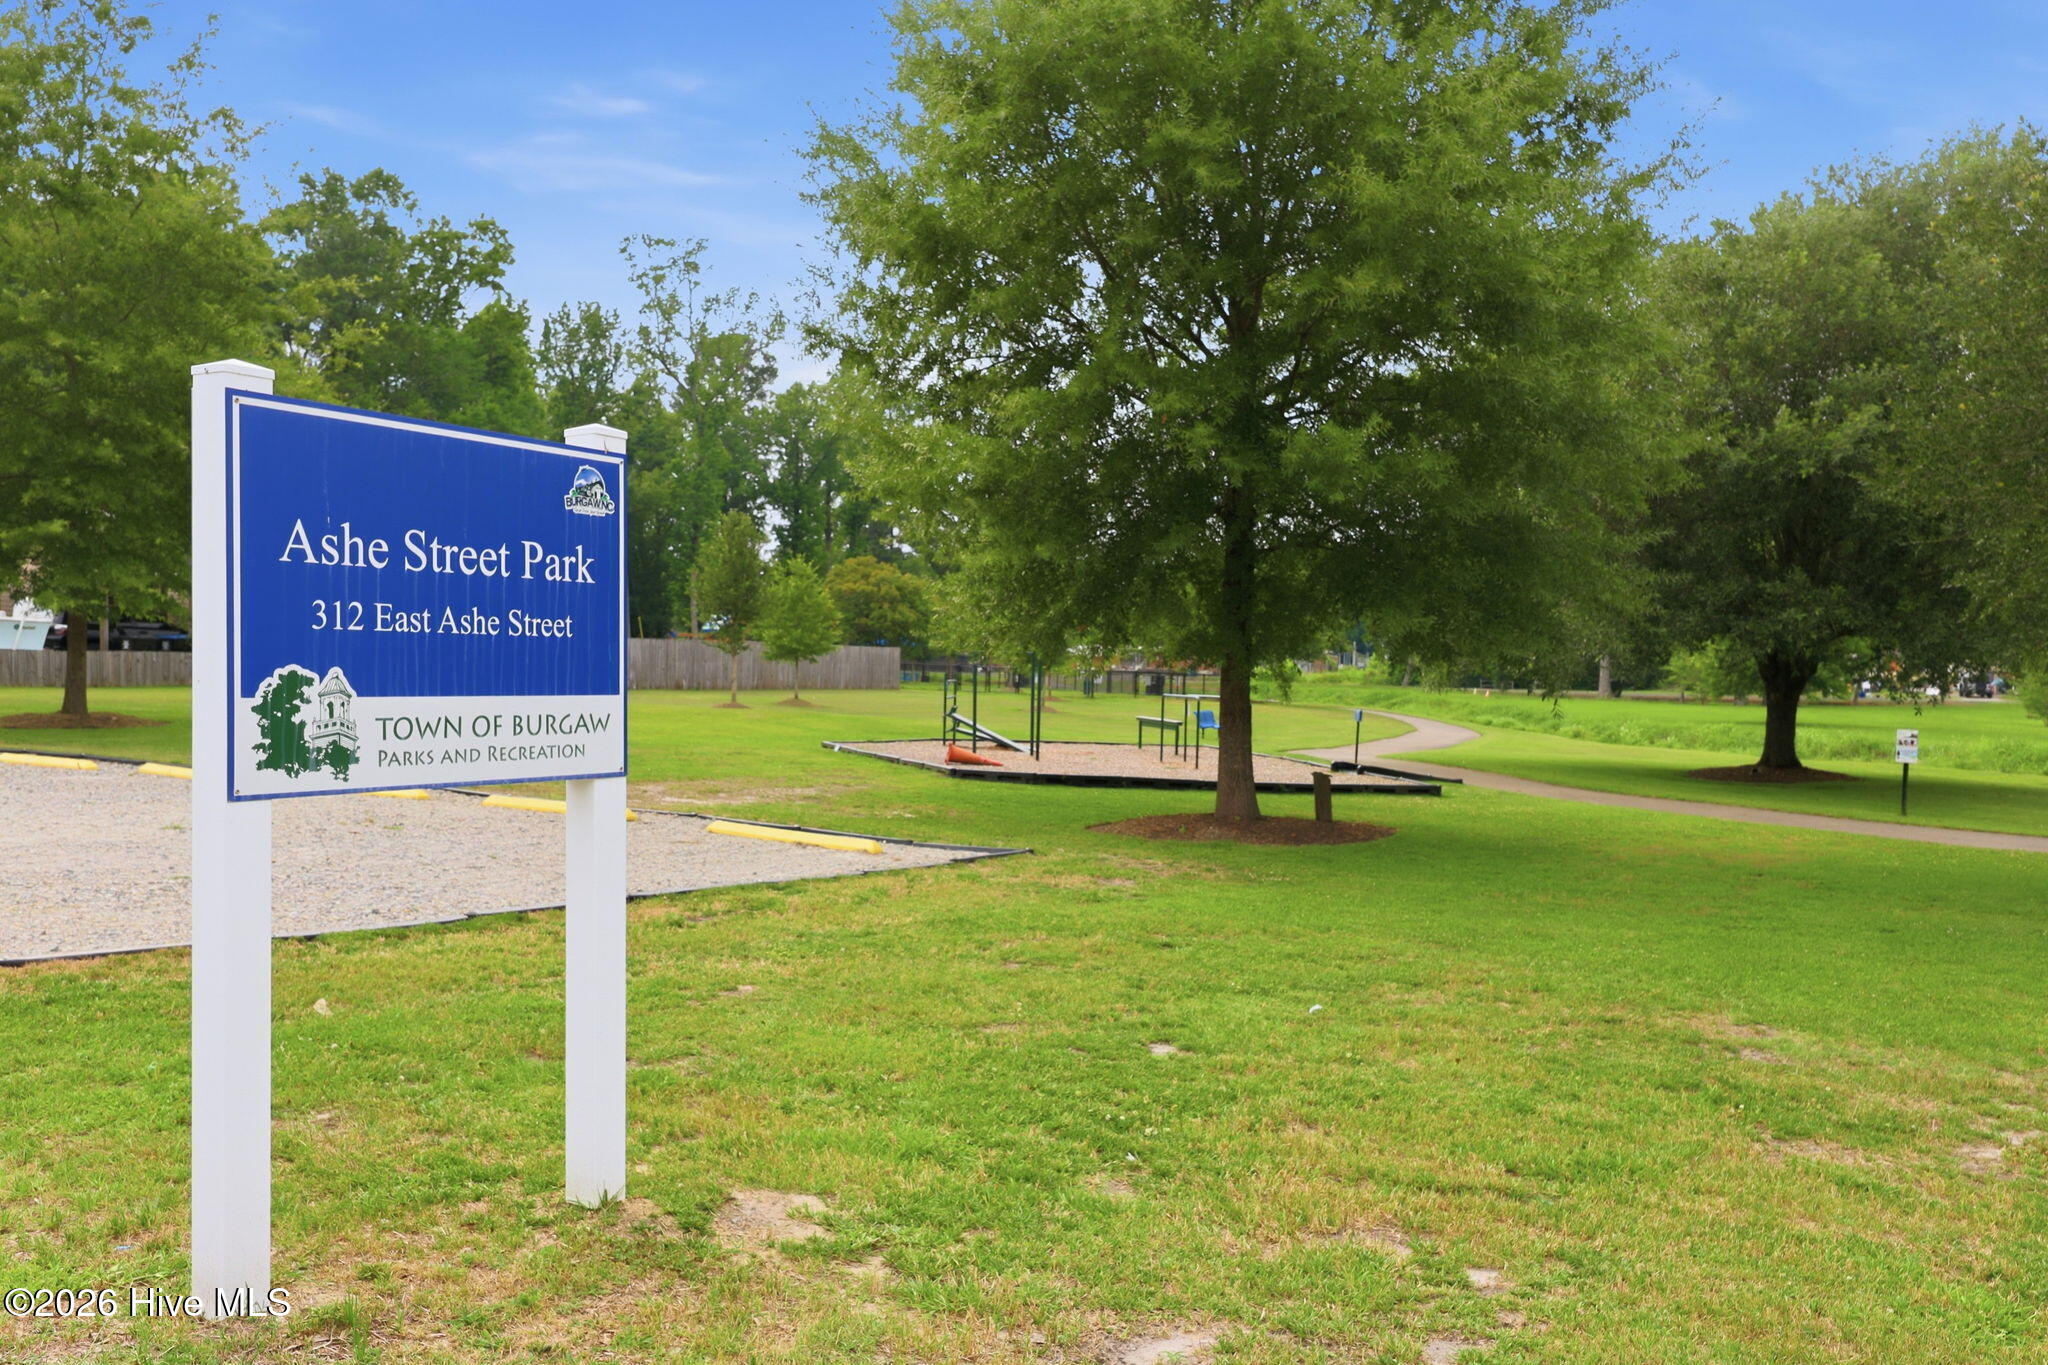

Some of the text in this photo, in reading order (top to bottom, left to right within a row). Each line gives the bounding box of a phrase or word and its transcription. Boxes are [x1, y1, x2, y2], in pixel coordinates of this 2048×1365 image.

[279, 518, 596, 584] Ashe Street Park
[311, 600, 574, 638] 312 East Ashe Street
[375, 712, 611, 741] TOWN OF BURGAW
[378, 743, 586, 768] PARKS AND RECREATION
